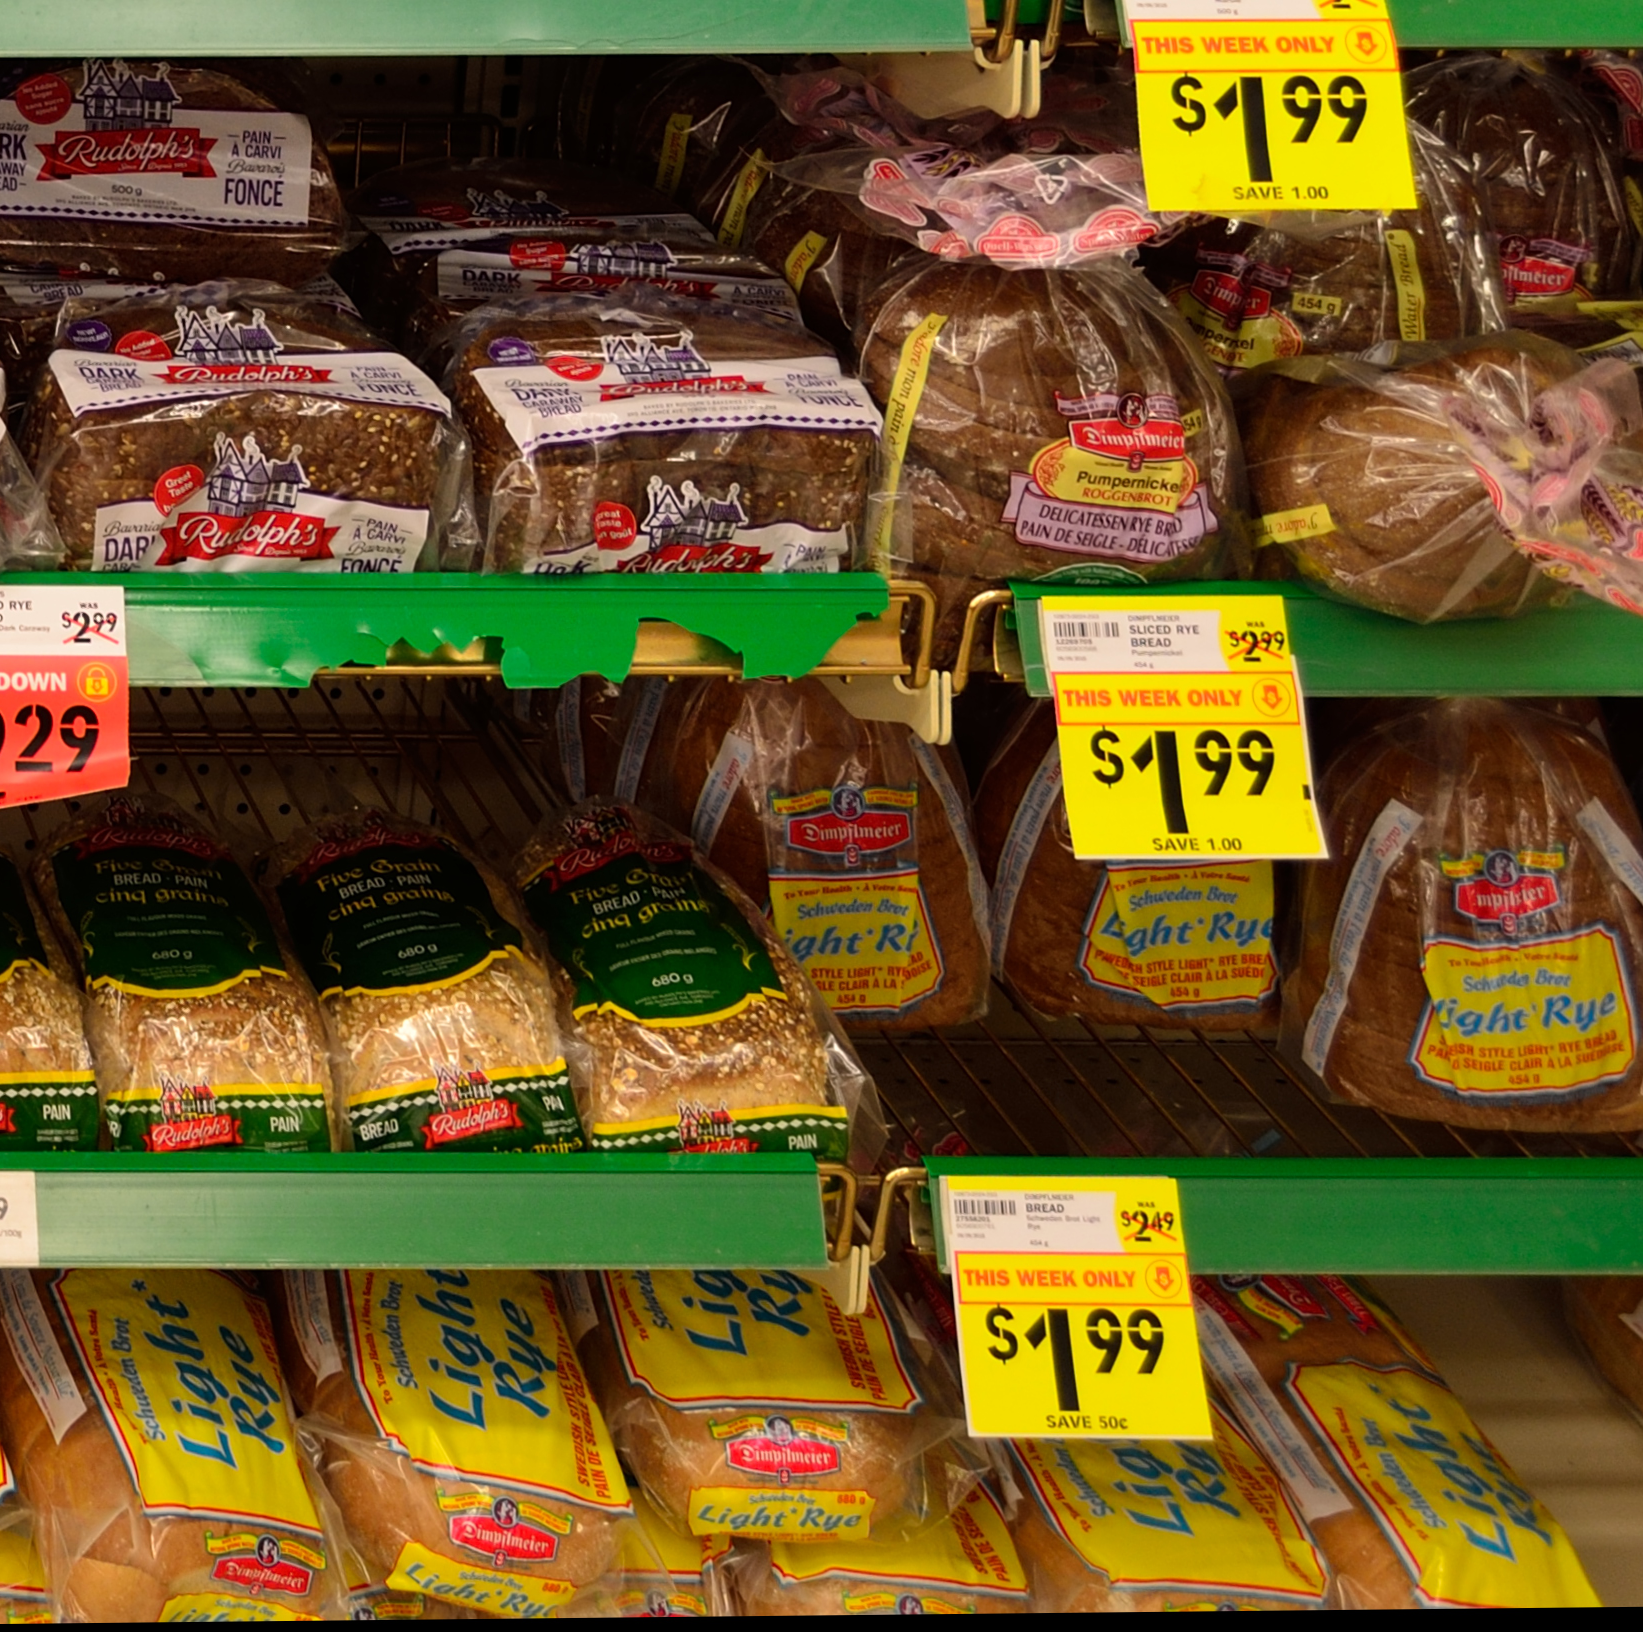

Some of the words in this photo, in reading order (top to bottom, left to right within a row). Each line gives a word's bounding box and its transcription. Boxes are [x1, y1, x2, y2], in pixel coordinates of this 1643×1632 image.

[1141, 37, 1194, 54] THIS
[1201, 37, 1269, 54] WEEK
[1276, 37, 1334, 53] ONLY
[58, 130, 194, 168] Rudolph's
[223, 175, 283, 208] FONCÉ
[1233, 187, 1283, 200] SAVE
[1291, 187, 1328, 199] 1.00
[1082, 486, 1173, 508] ROGGENBROT
[9, 601, 32, 610] RYE
[1129, 625, 1171, 634] SLICED
[1176, 625, 1199, 634] RYE
[1131, 638, 1171, 647] BREAD
[1063, 690, 1112, 706] THIS
[1118, 690, 1181, 706] WEEK
[1187, 689, 1242, 706] ONLY
[1153, 838, 1200, 850] SAVE
[1207, 838, 1242, 850] 1.00
[1204, 887, 1238, 906] Brot
[652, 973, 679, 990] 680
[1543, 990, 1617, 1027] Rye
[43, 1103, 71, 1122] PAIN
[1026, 1203, 1064, 1213] BREAD
[963, 1270, 1009, 1286] THIS
[1016, 1270, 1077, 1286] WEEK
[1083, 1270, 1135, 1287] ONLY
[1046, 1413, 1092, 1430] SAVE
[739, 1444, 834, 1468] Dimpflmeier
[698, 1503, 785, 1532] Light
